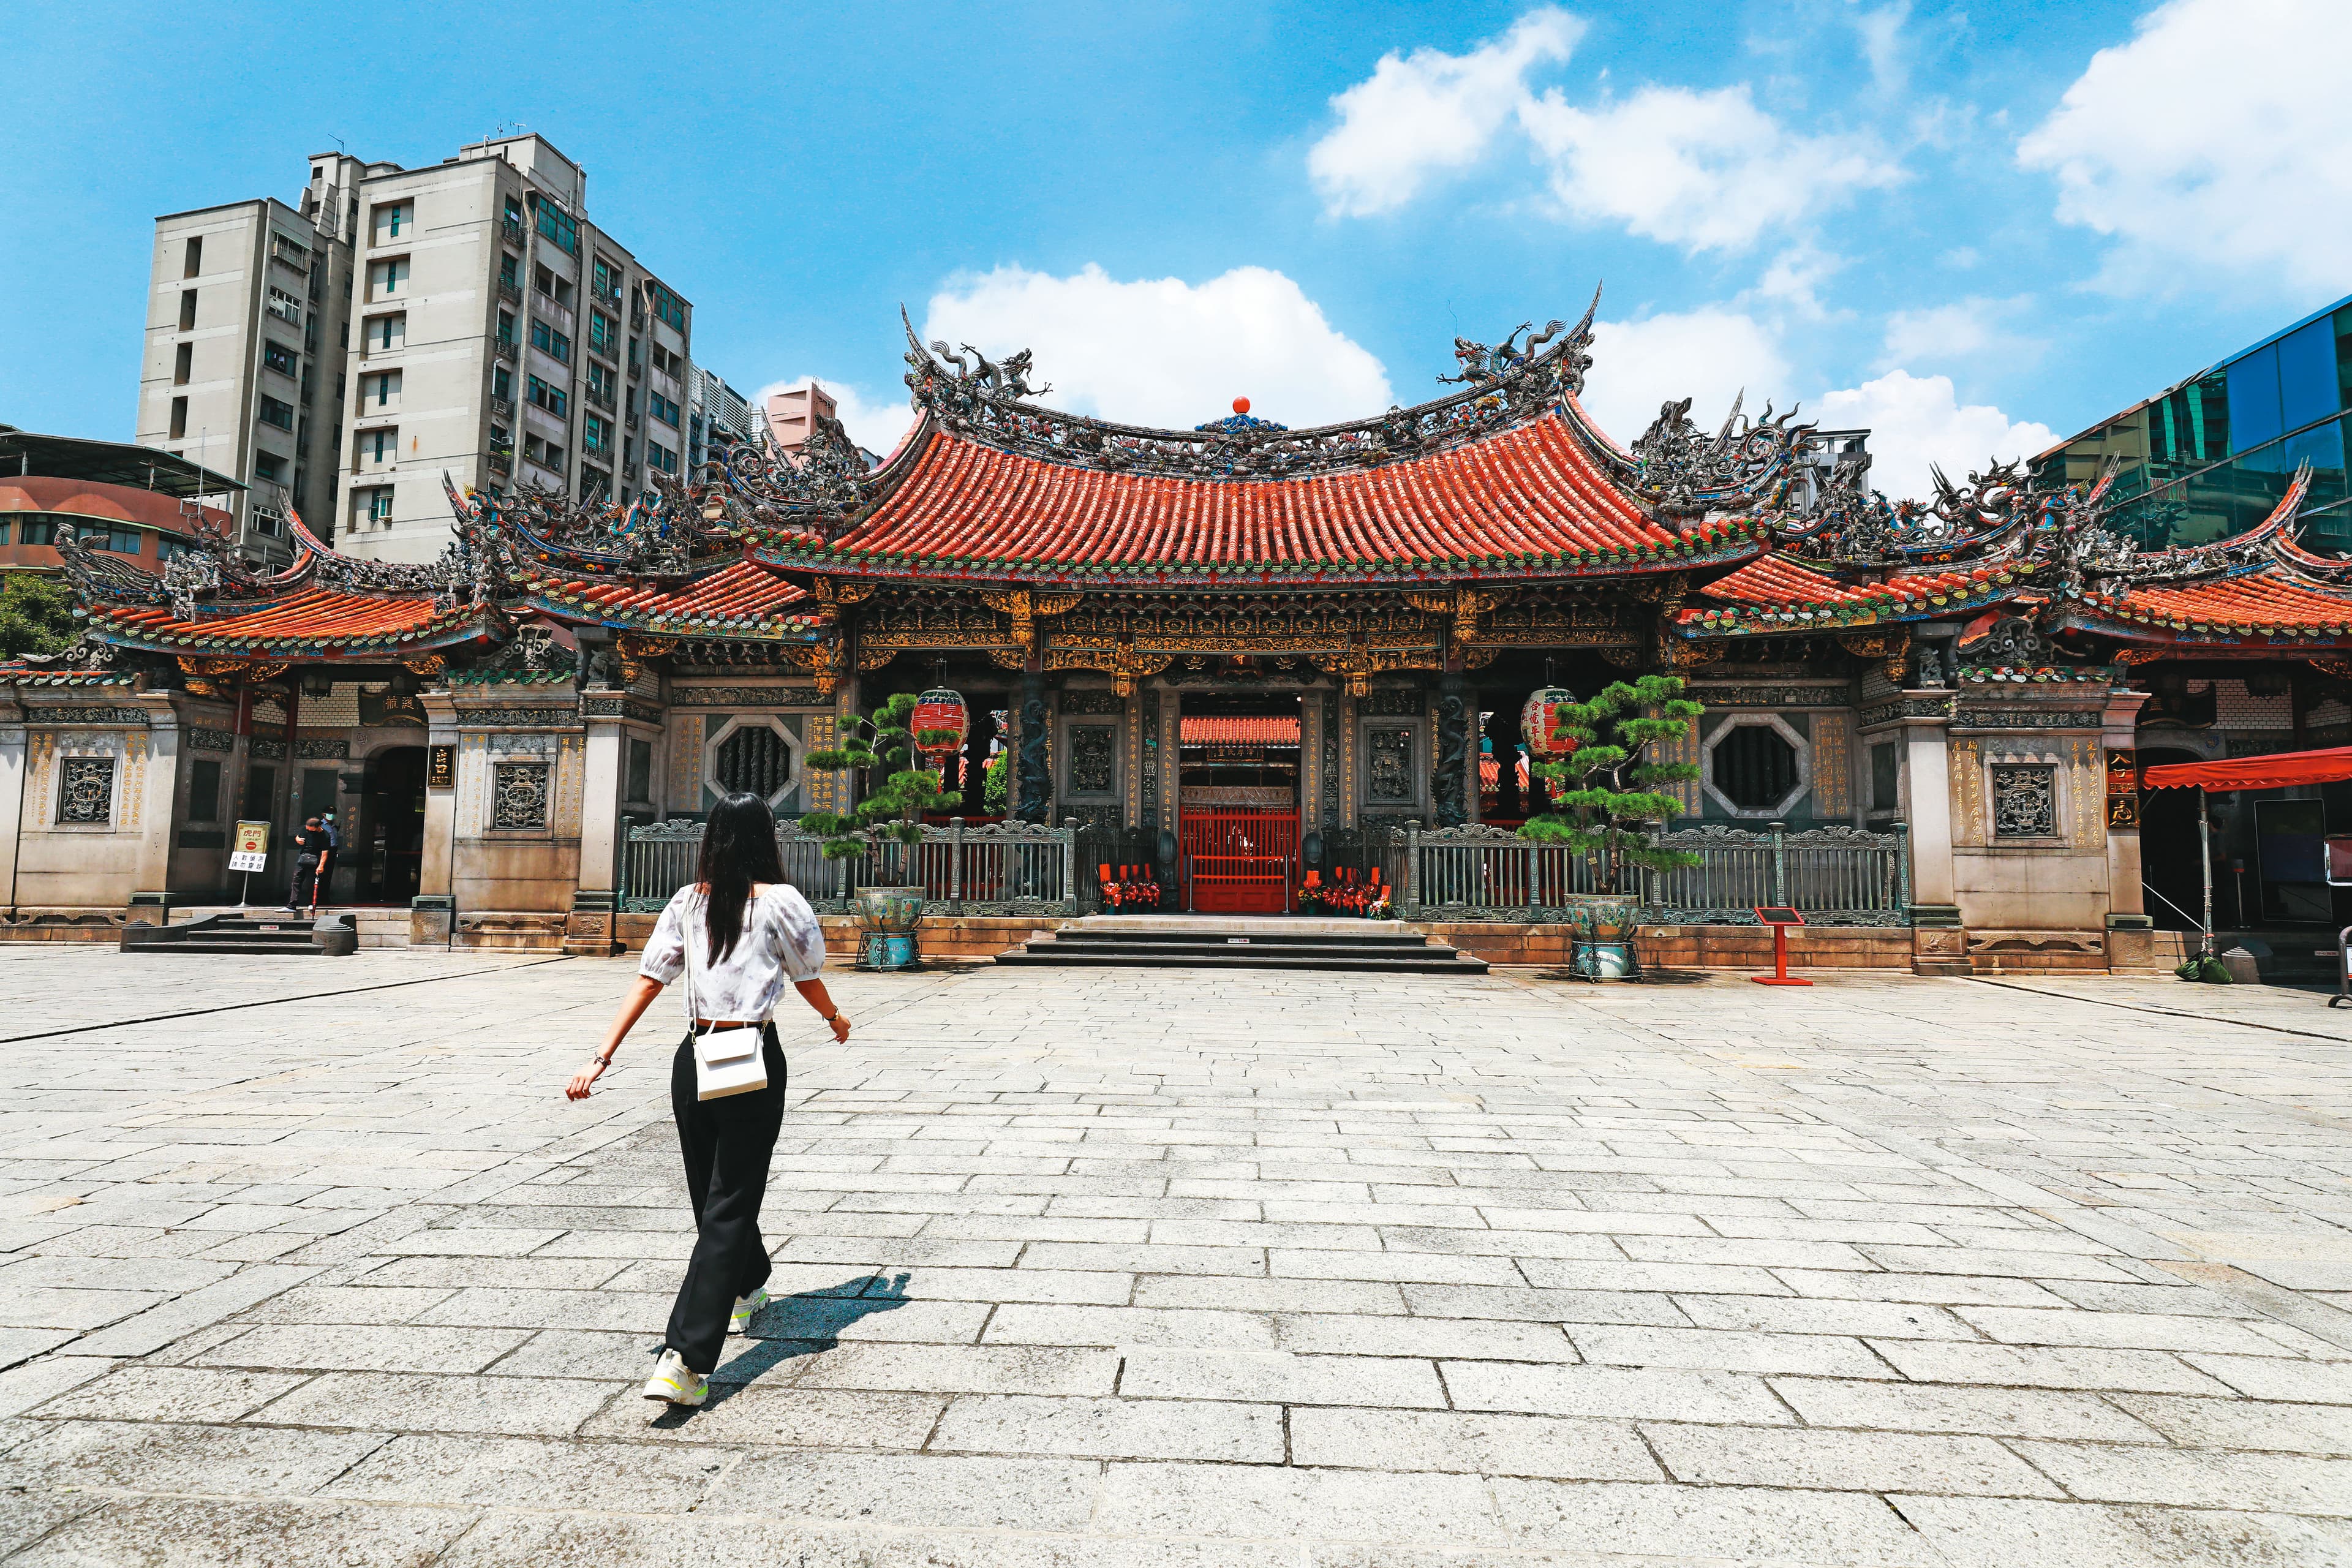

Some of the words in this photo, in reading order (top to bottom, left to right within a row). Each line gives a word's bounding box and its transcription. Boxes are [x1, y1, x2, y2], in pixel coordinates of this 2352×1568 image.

[435, 748, 448, 774] 出口
[2111, 753, 2132, 778] 入口
[232, 861, 262, 870] 請勿穿越
